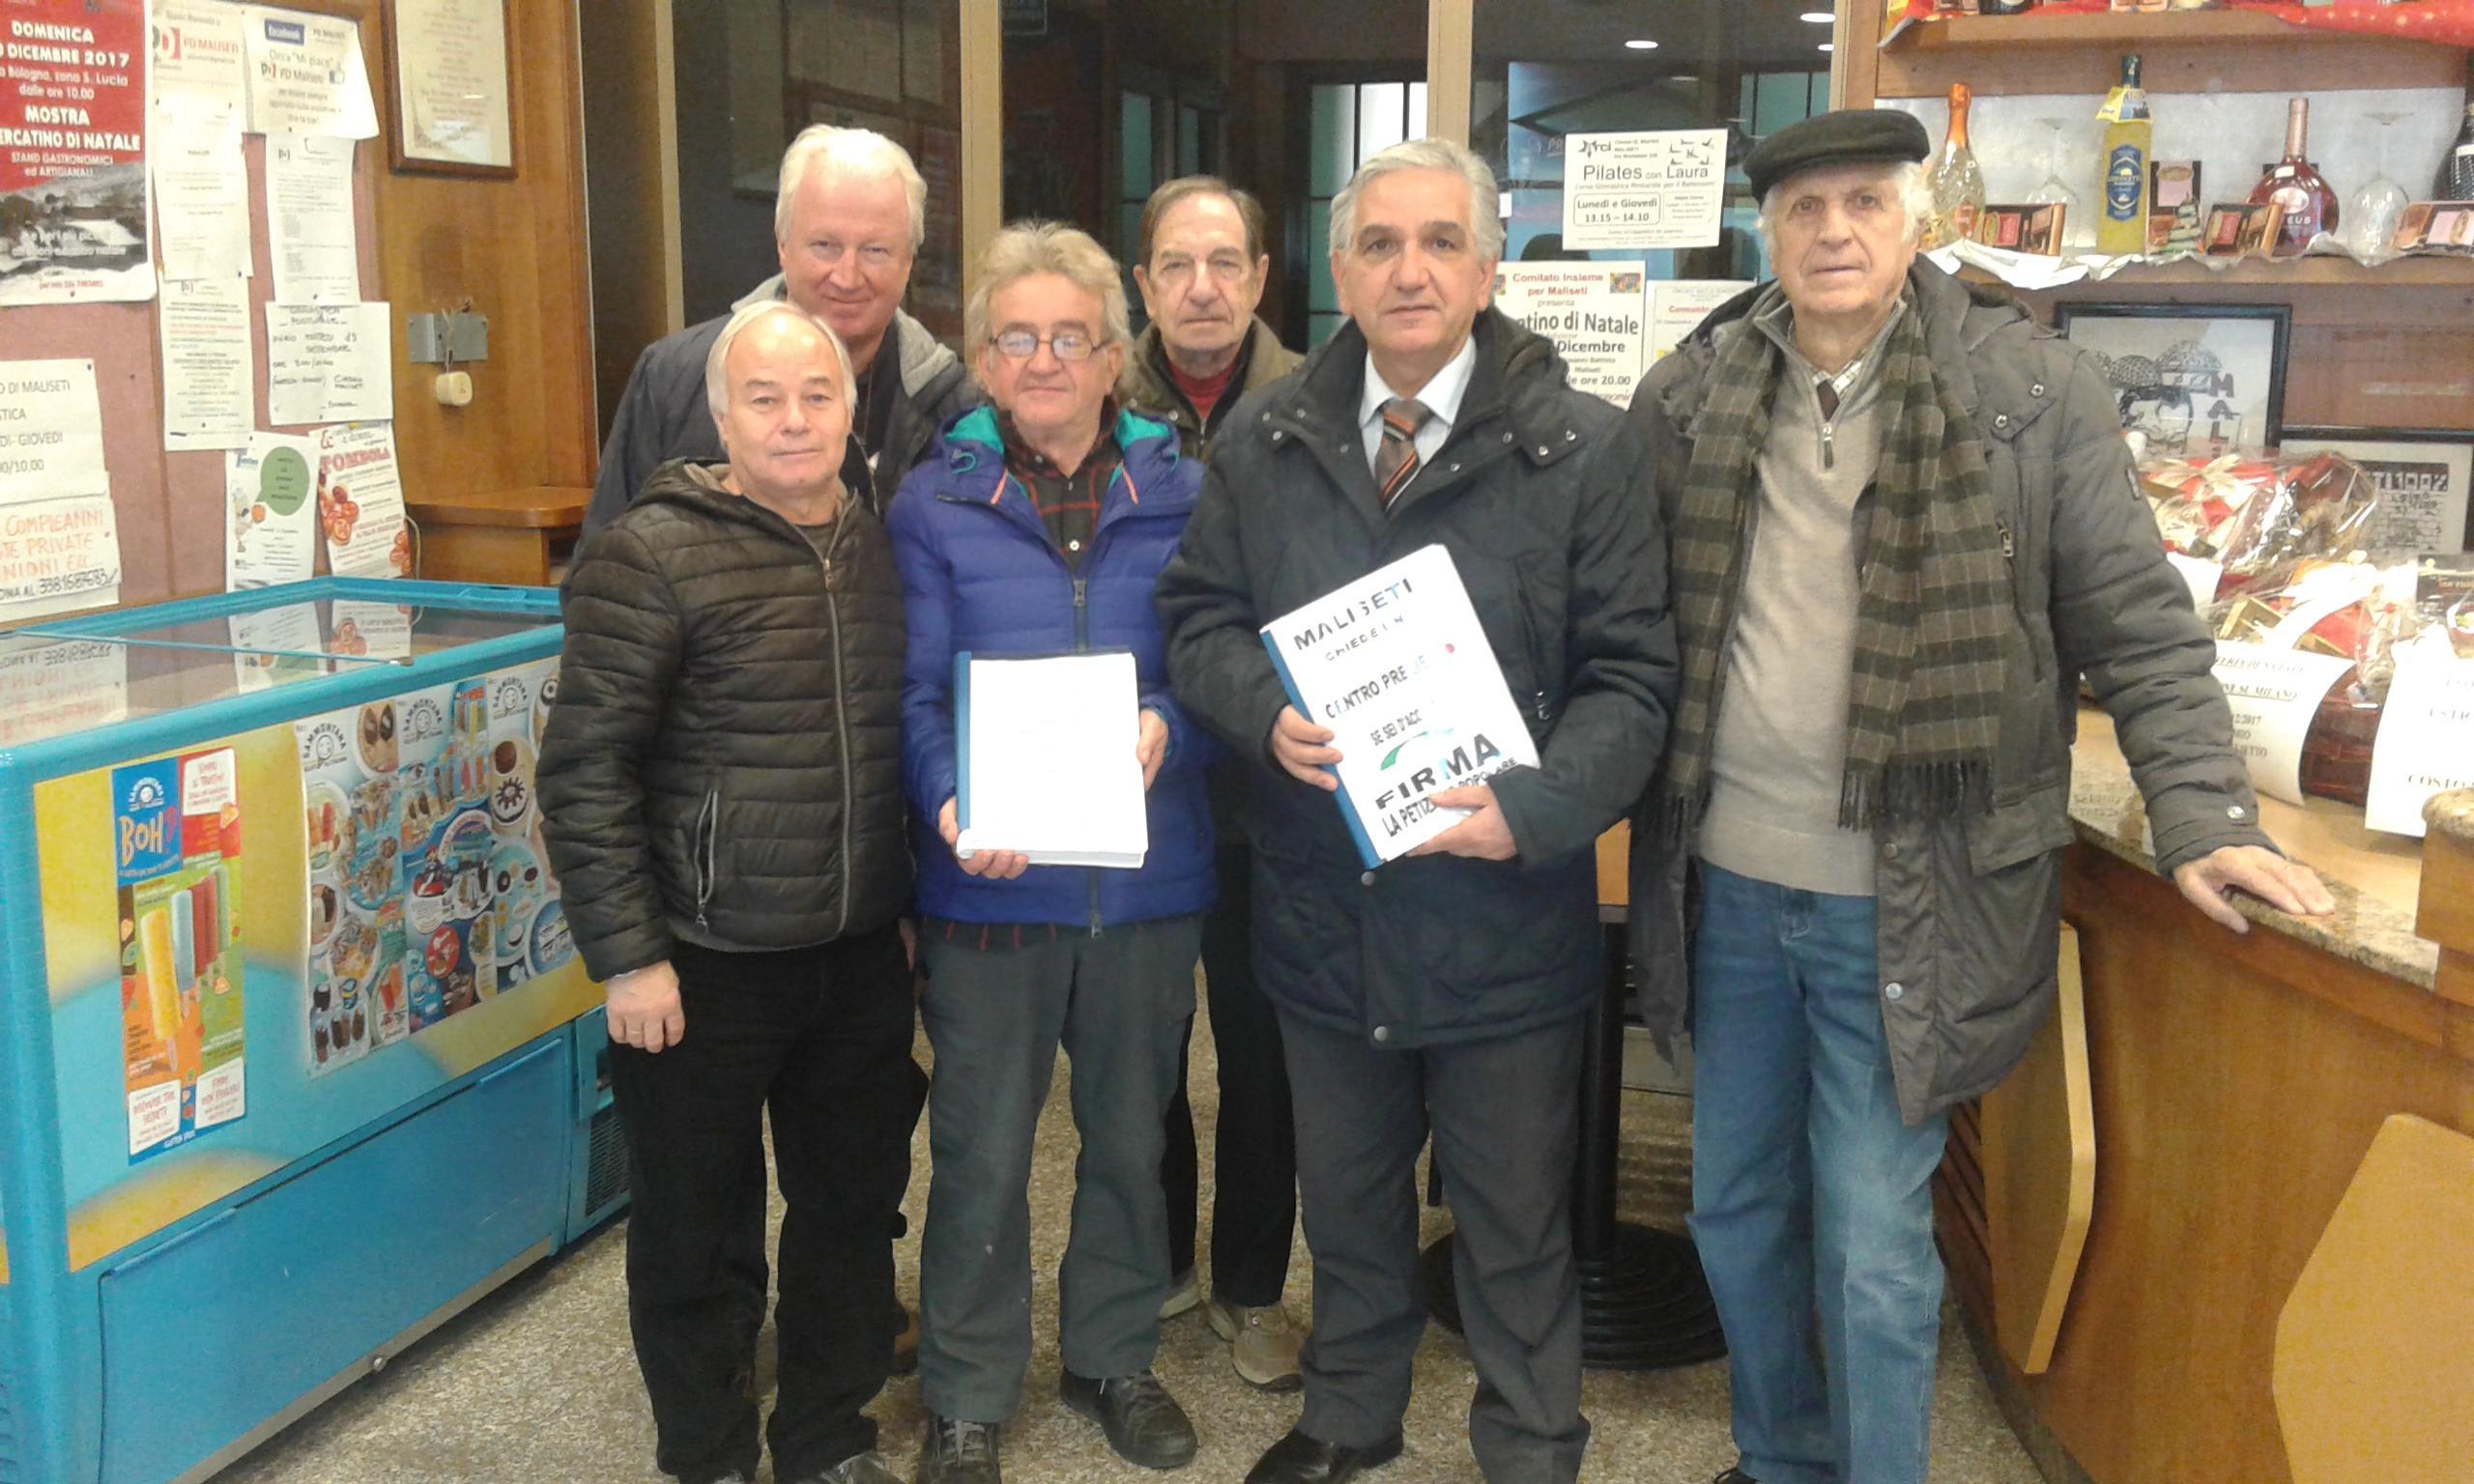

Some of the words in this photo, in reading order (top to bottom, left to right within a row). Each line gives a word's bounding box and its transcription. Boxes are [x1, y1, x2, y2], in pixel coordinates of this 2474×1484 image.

[12, 20, 95, 43] DOMENICA
[7, 43, 80, 65] DICEMBRE
[84, 49, 129, 68] 2017
[96, 72, 129, 86] Lucia
[67, 87, 95, 100] 10.00
[25, 104, 91, 127] MOSTRA
[66, 131, 80, 149] DI
[83, 131, 141, 152] NATALE
[11, 152, 40, 163] STAND
[42, 154, 114, 165] GASTRONOMICI
[1583, 165, 1643, 181] Pilates
[1666, 166, 1709, 179] Laura
[1585, 214, 1611, 223] 13.15
[1623, 213, 1650, 222] 14.10
[1512, 273, 1560, 282] Comitato
[1563, 273, 1604, 282] Insieme
[1528, 288, 1545, 297] per
[1564, 310, 1579, 330] di
[1584, 312, 1639, 335] Natale
[1557, 340, 1625, 354] Dicembre
[8, 382, 18, 394] DI
[22, 380, 70, 393] MALISETI
[1601, 376, 1631, 385] 20.00
[18, 431, 63, 446] GIOVEDI
[26, 531, 93, 556] PRIVATE
[1293, 577, 1414, 651] MALISETI
[1375, 732, 1502, 811] FIRMA
[1381, 813, 1403, 839] LA
